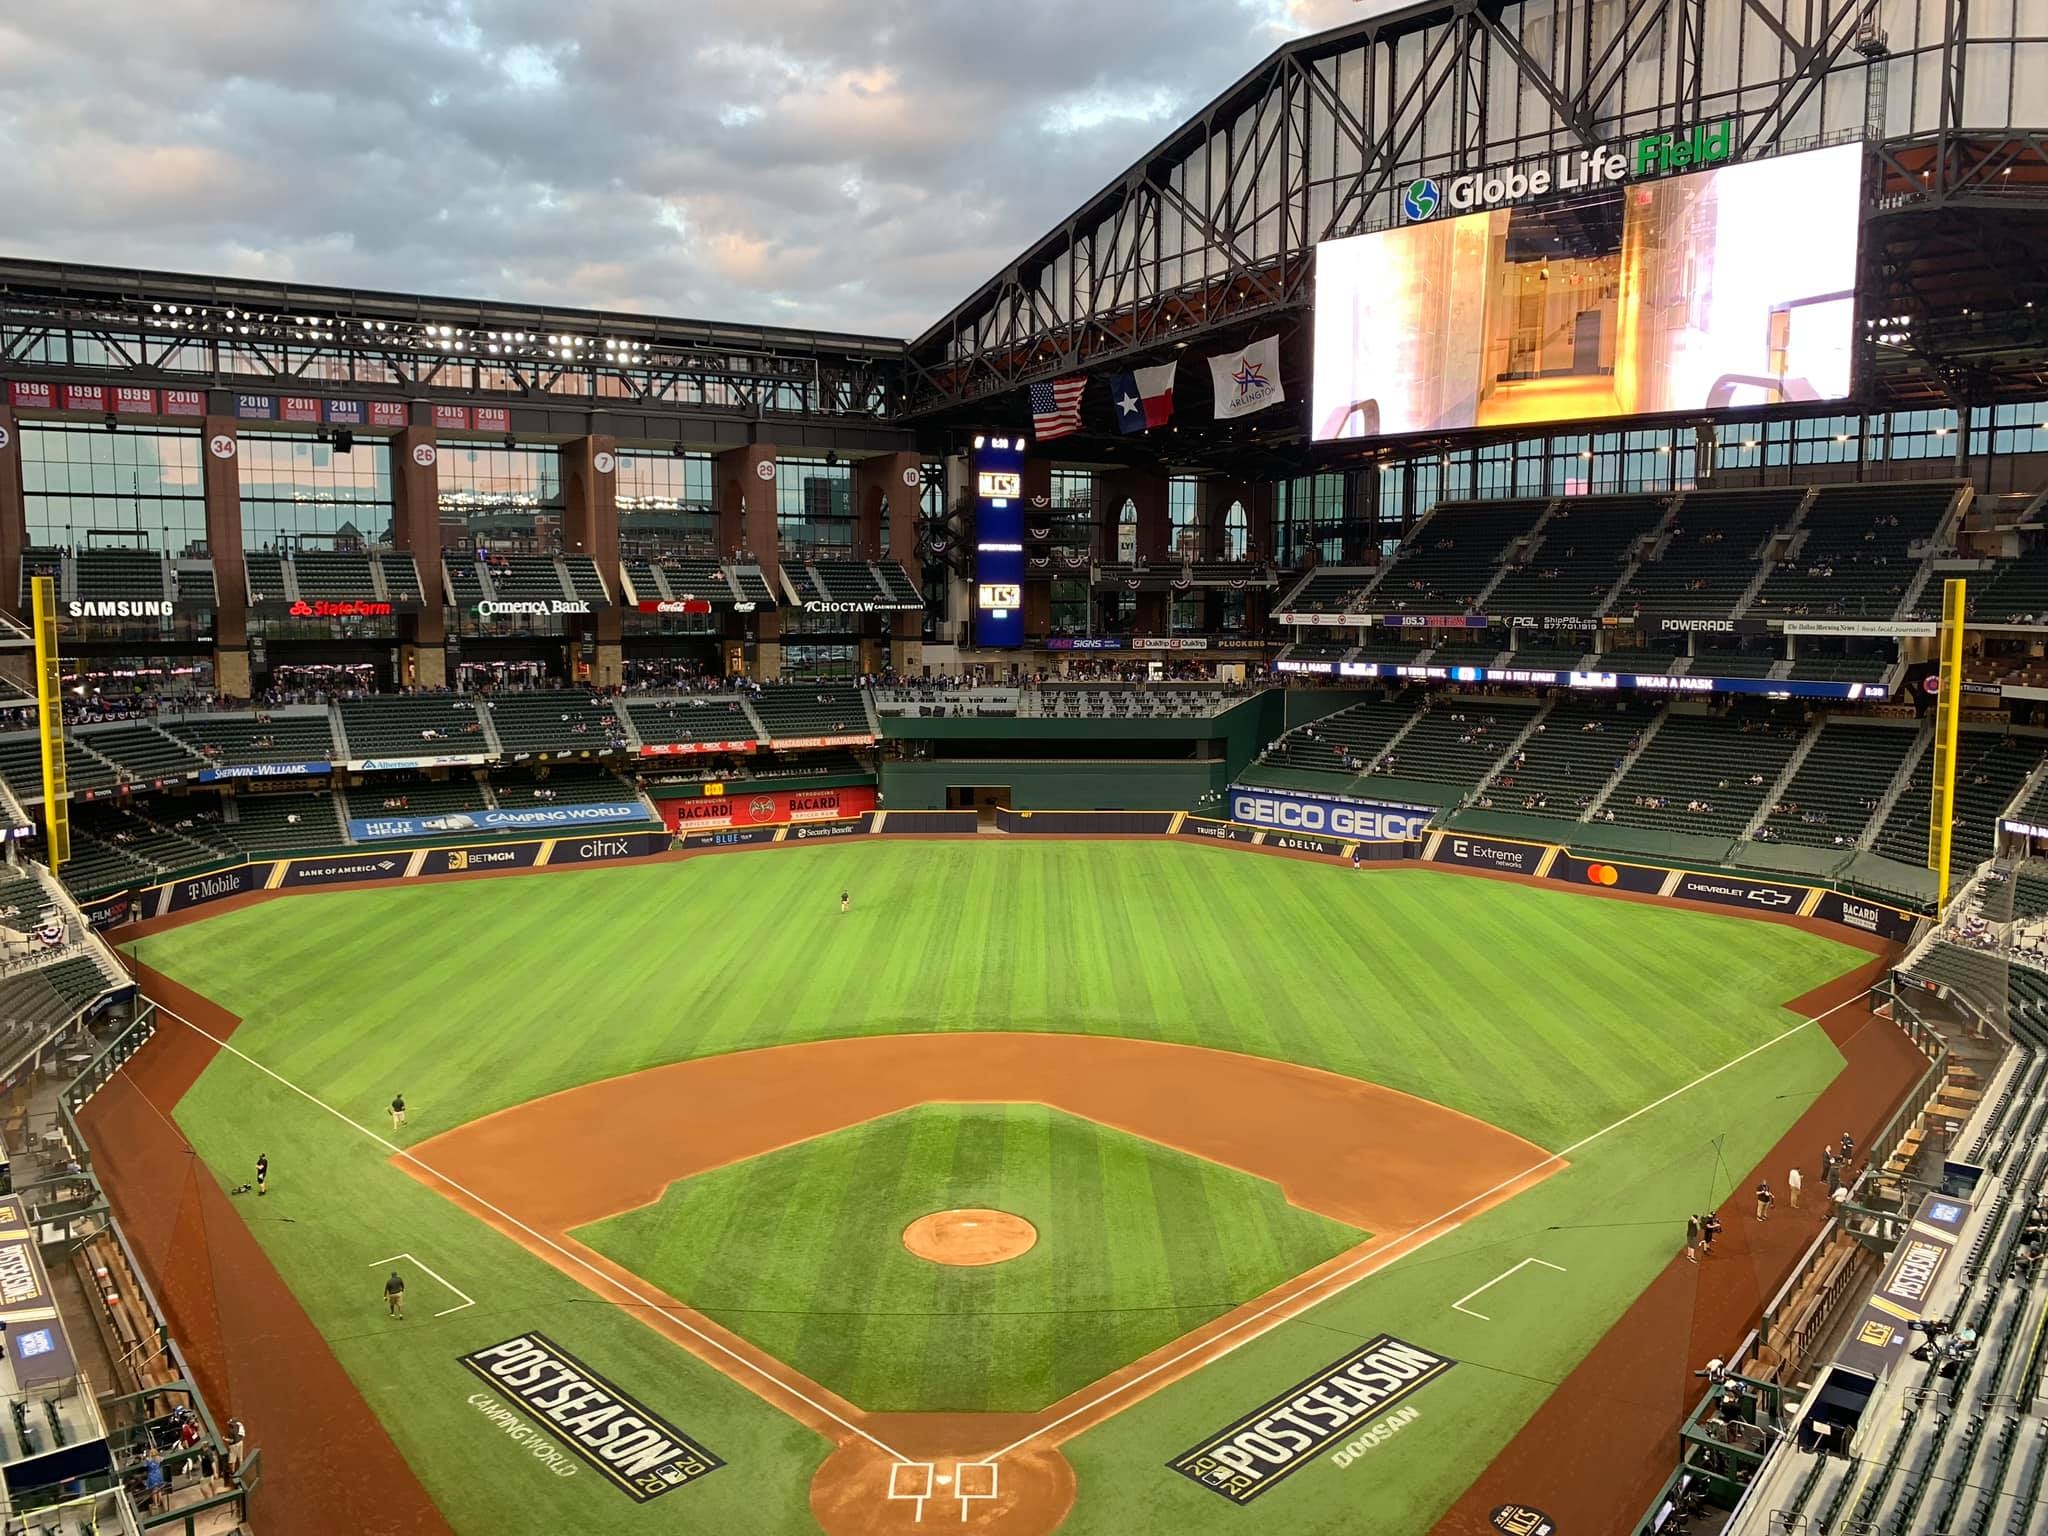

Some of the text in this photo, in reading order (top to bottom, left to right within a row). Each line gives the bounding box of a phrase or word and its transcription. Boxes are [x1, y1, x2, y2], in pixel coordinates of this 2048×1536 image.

[1450, 120, 1730, 210] Globe Life Field
[15, 382, 49, 396] 1996
[68, 385, 102, 398] 1998
[117, 388, 151, 401] 1999
[168, 390, 199, 404] 2010
[239, 395, 269, 408] 2010
[1229, 387, 1276, 408] ARLINGTON
[287, 398, 315, 410] 2011
[331, 400, 358, 412] 2011
[374, 402, 402, 415] 2012
[437, 405, 464, 418] 2015
[478, 408, 504, 420] 2016
[214, 440, 233, 453] 34
[416, 449, 433, 461] 26
[600, 456, 609, 469] 7
[759, 465, 773, 476] 29
[906, 471, 917, 483] 10
[69, 601, 174, 617] SAMSUNG
[552, 600, 590, 613] Bank
[811, 600, 874, 613] CHOCTAW
[1402, 616, 1425, 625] 105.3
[1512, 617, 1538, 627] PGL
[1544, 616, 1598, 624] ShipPGL.com
[1661, 619, 1734, 632] POWERADE
[1218, 640, 1265, 648] PLUCKERS
[1635, 676, 1713, 690] WEAR A MASK
[789, 794, 840, 811] BACARDÍ
[485, 807, 632, 823] CAMPING WORLD
[678, 801, 732, 819] BACARDÍ
[1234, 796, 1429, 840] GEICO GEICO
[366, 822, 393, 830] HIT
[807, 826, 853, 838] Security Benefit
[1197, 826, 1216, 836] TRUIST
[716, 834, 738, 844] BLUE
[1289, 839, 1324, 852] DELTA
[580, 838, 628, 859] citrix
[1473, 845, 1522, 862] Extreme
[468, 852, 515, 863] BETMGM
[1495, 860, 1522, 868] networks
[299, 865, 377, 877] BANK OF AMERICA
[1687, 882, 1744, 897] CHEVROLET
[1842, 902, 1879, 922] BACARDÍ
[1887, 1247, 1942, 1300] POSTSEASON
[474, 1337, 684, 1478] POSTSEASON
[1208, 1341, 1441, 1480] POSTSEASON
[467, 1393, 578, 1478] CAMPING WORLD
[1330, 1405, 1421, 1469] DOOSAN
[674, 1456, 706, 1476] 20
[1186, 1457, 1213, 1477] 20
[635, 1473, 668, 1494] 20
[1220, 1474, 1253, 1496] 20
